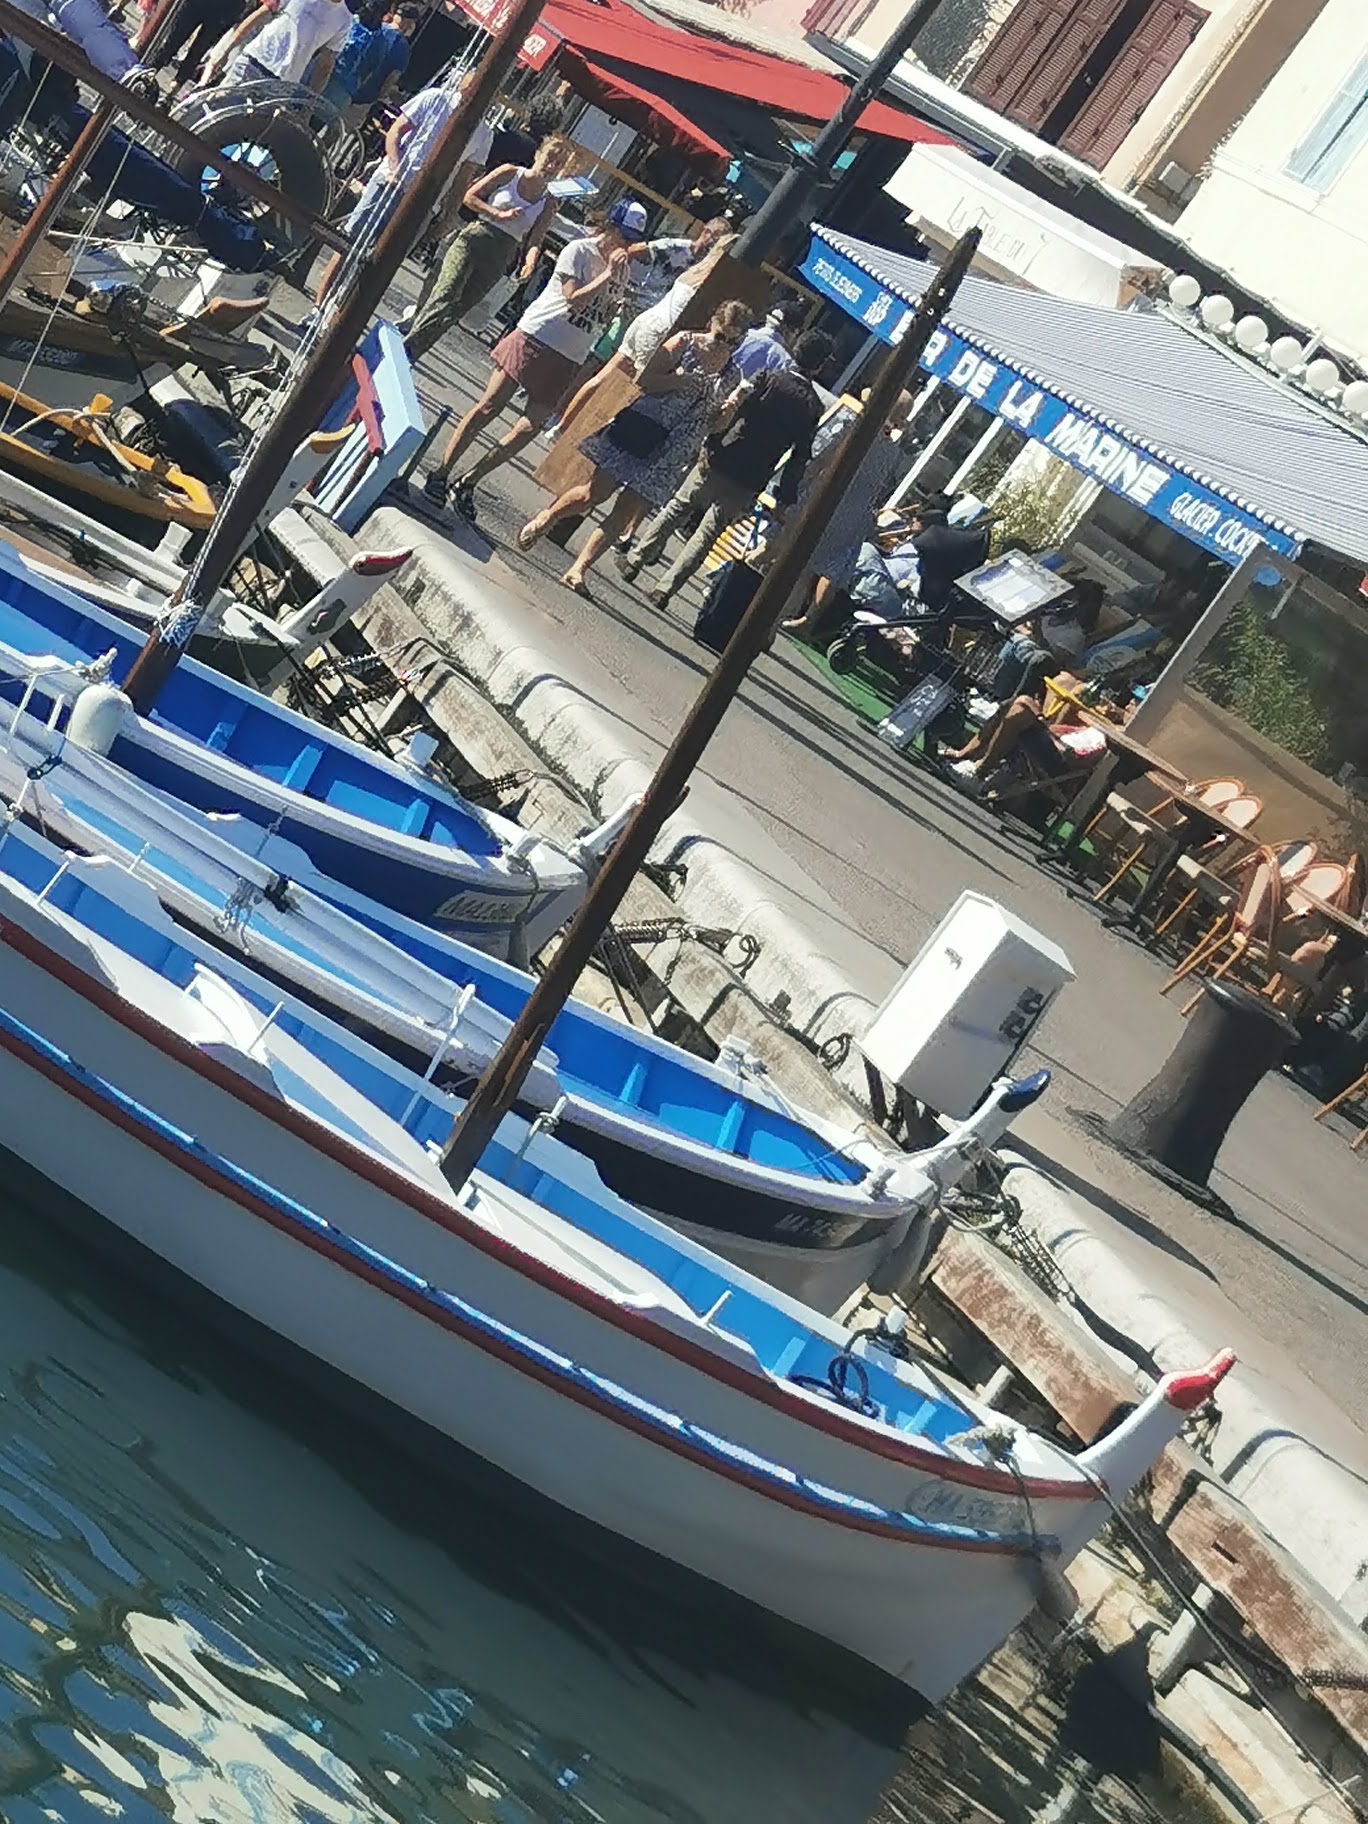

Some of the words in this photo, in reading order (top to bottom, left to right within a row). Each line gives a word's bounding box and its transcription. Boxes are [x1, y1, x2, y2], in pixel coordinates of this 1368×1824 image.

[889, 310, 947, 366] BR
[947, 350, 997, 399] DE
[999, 380, 1043, 428] LA
[1044, 413, 1171, 506] MARINE
